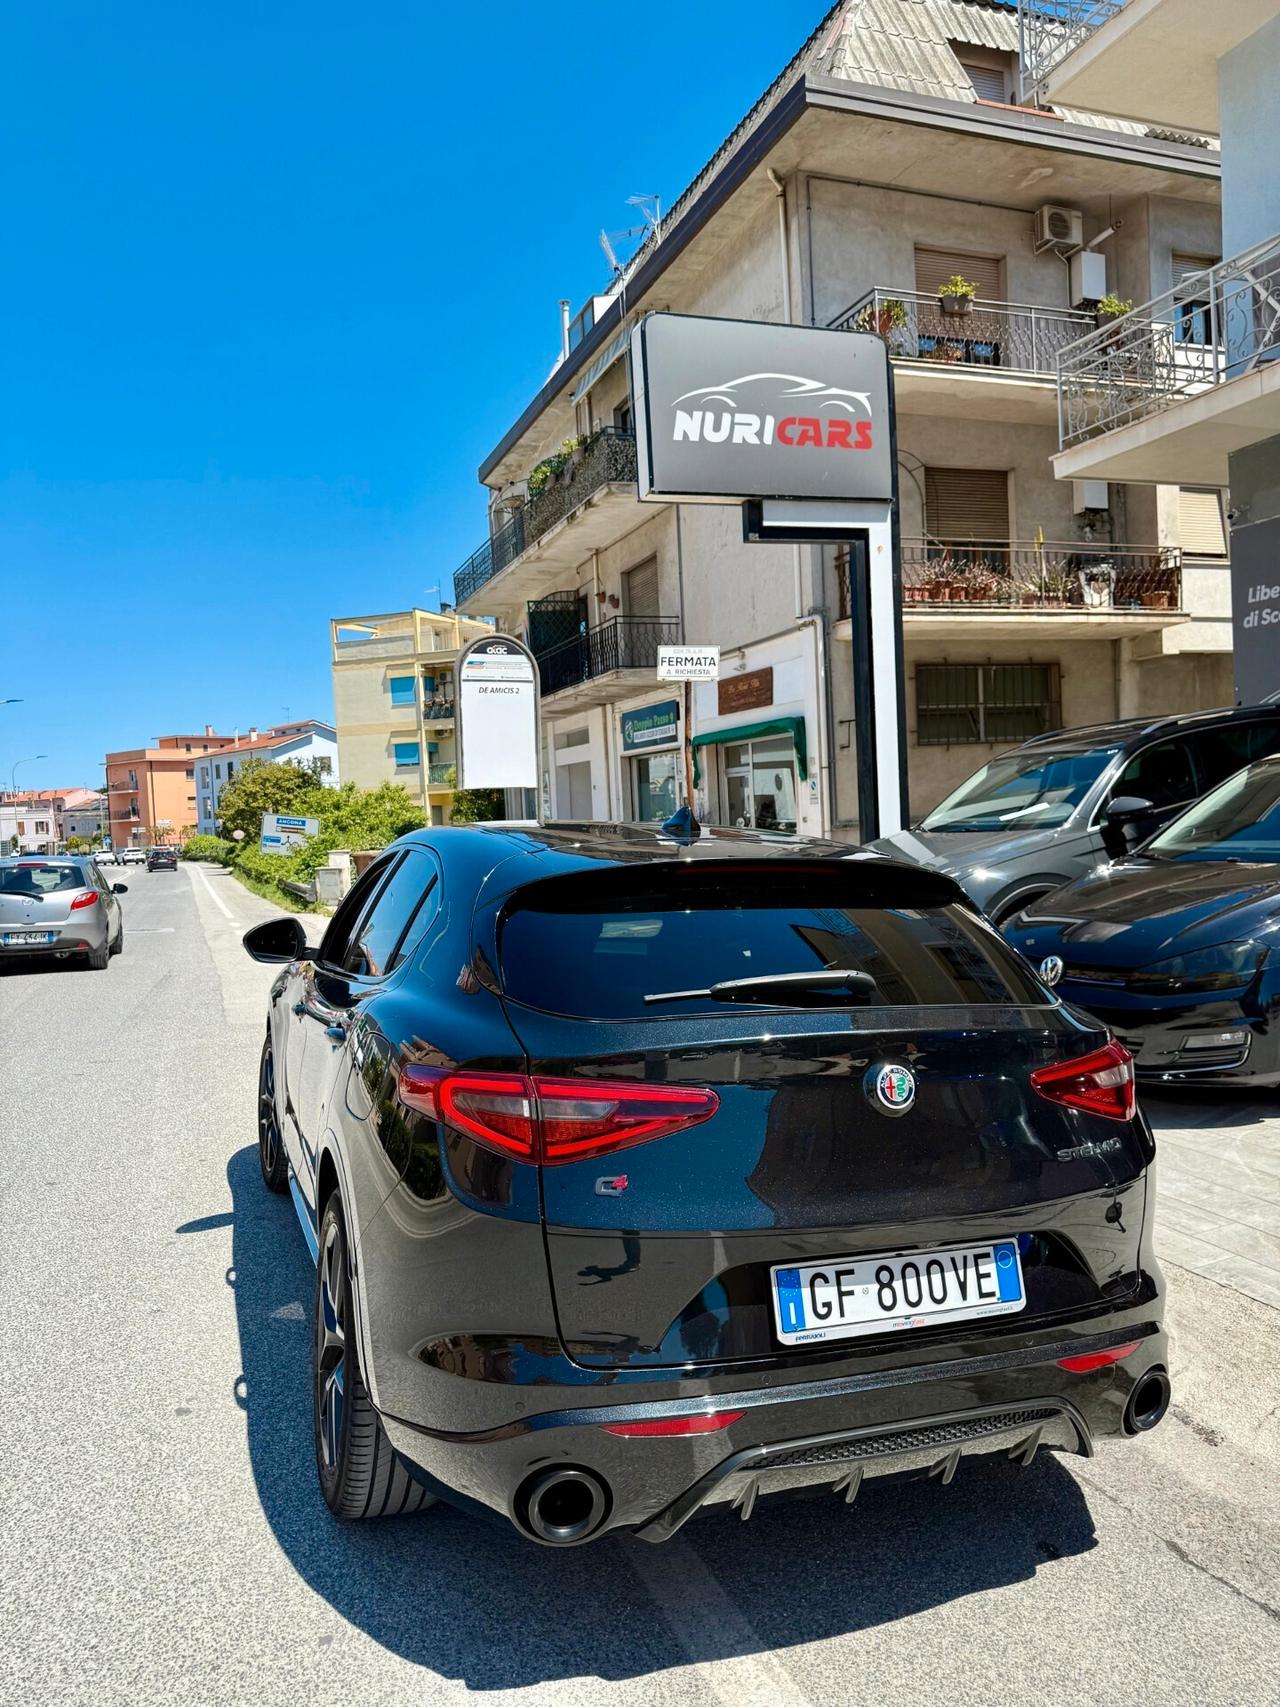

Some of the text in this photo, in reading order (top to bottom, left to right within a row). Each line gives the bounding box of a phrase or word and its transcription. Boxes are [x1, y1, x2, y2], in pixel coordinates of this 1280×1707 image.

[1243, 608, 1280, 629] di Sc
[660, 656, 716, 667] FERMATA
[675, 668, 711, 676] RICHIESTA
[478, 686, 520, 695] DE AMICIS 2
[809, 1268, 855, 1320] GF
[874, 1252, 997, 1312] 800VE
